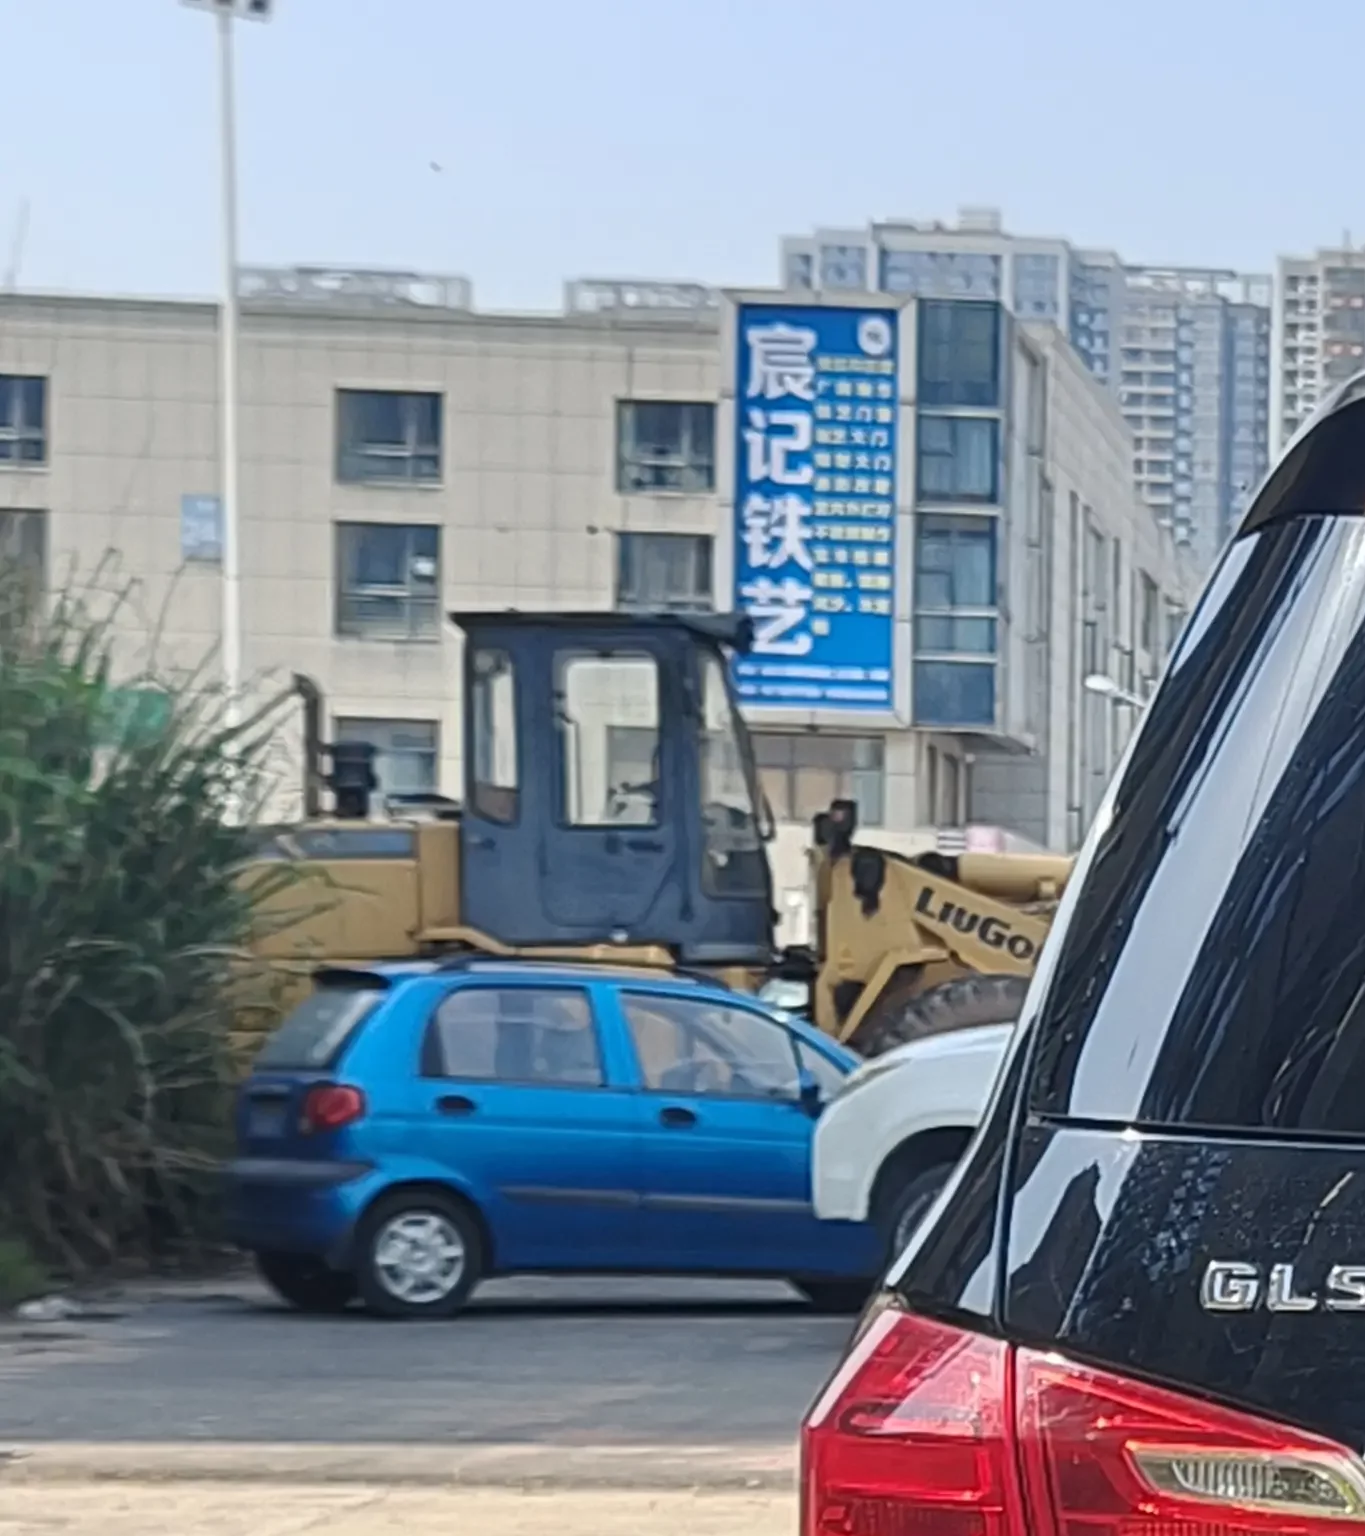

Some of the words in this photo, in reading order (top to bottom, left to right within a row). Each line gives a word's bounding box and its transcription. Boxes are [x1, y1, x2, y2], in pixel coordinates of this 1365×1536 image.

[741, 322, 818, 657] 宸记铁艺
[915, 886, 1043, 962] LIUGO
